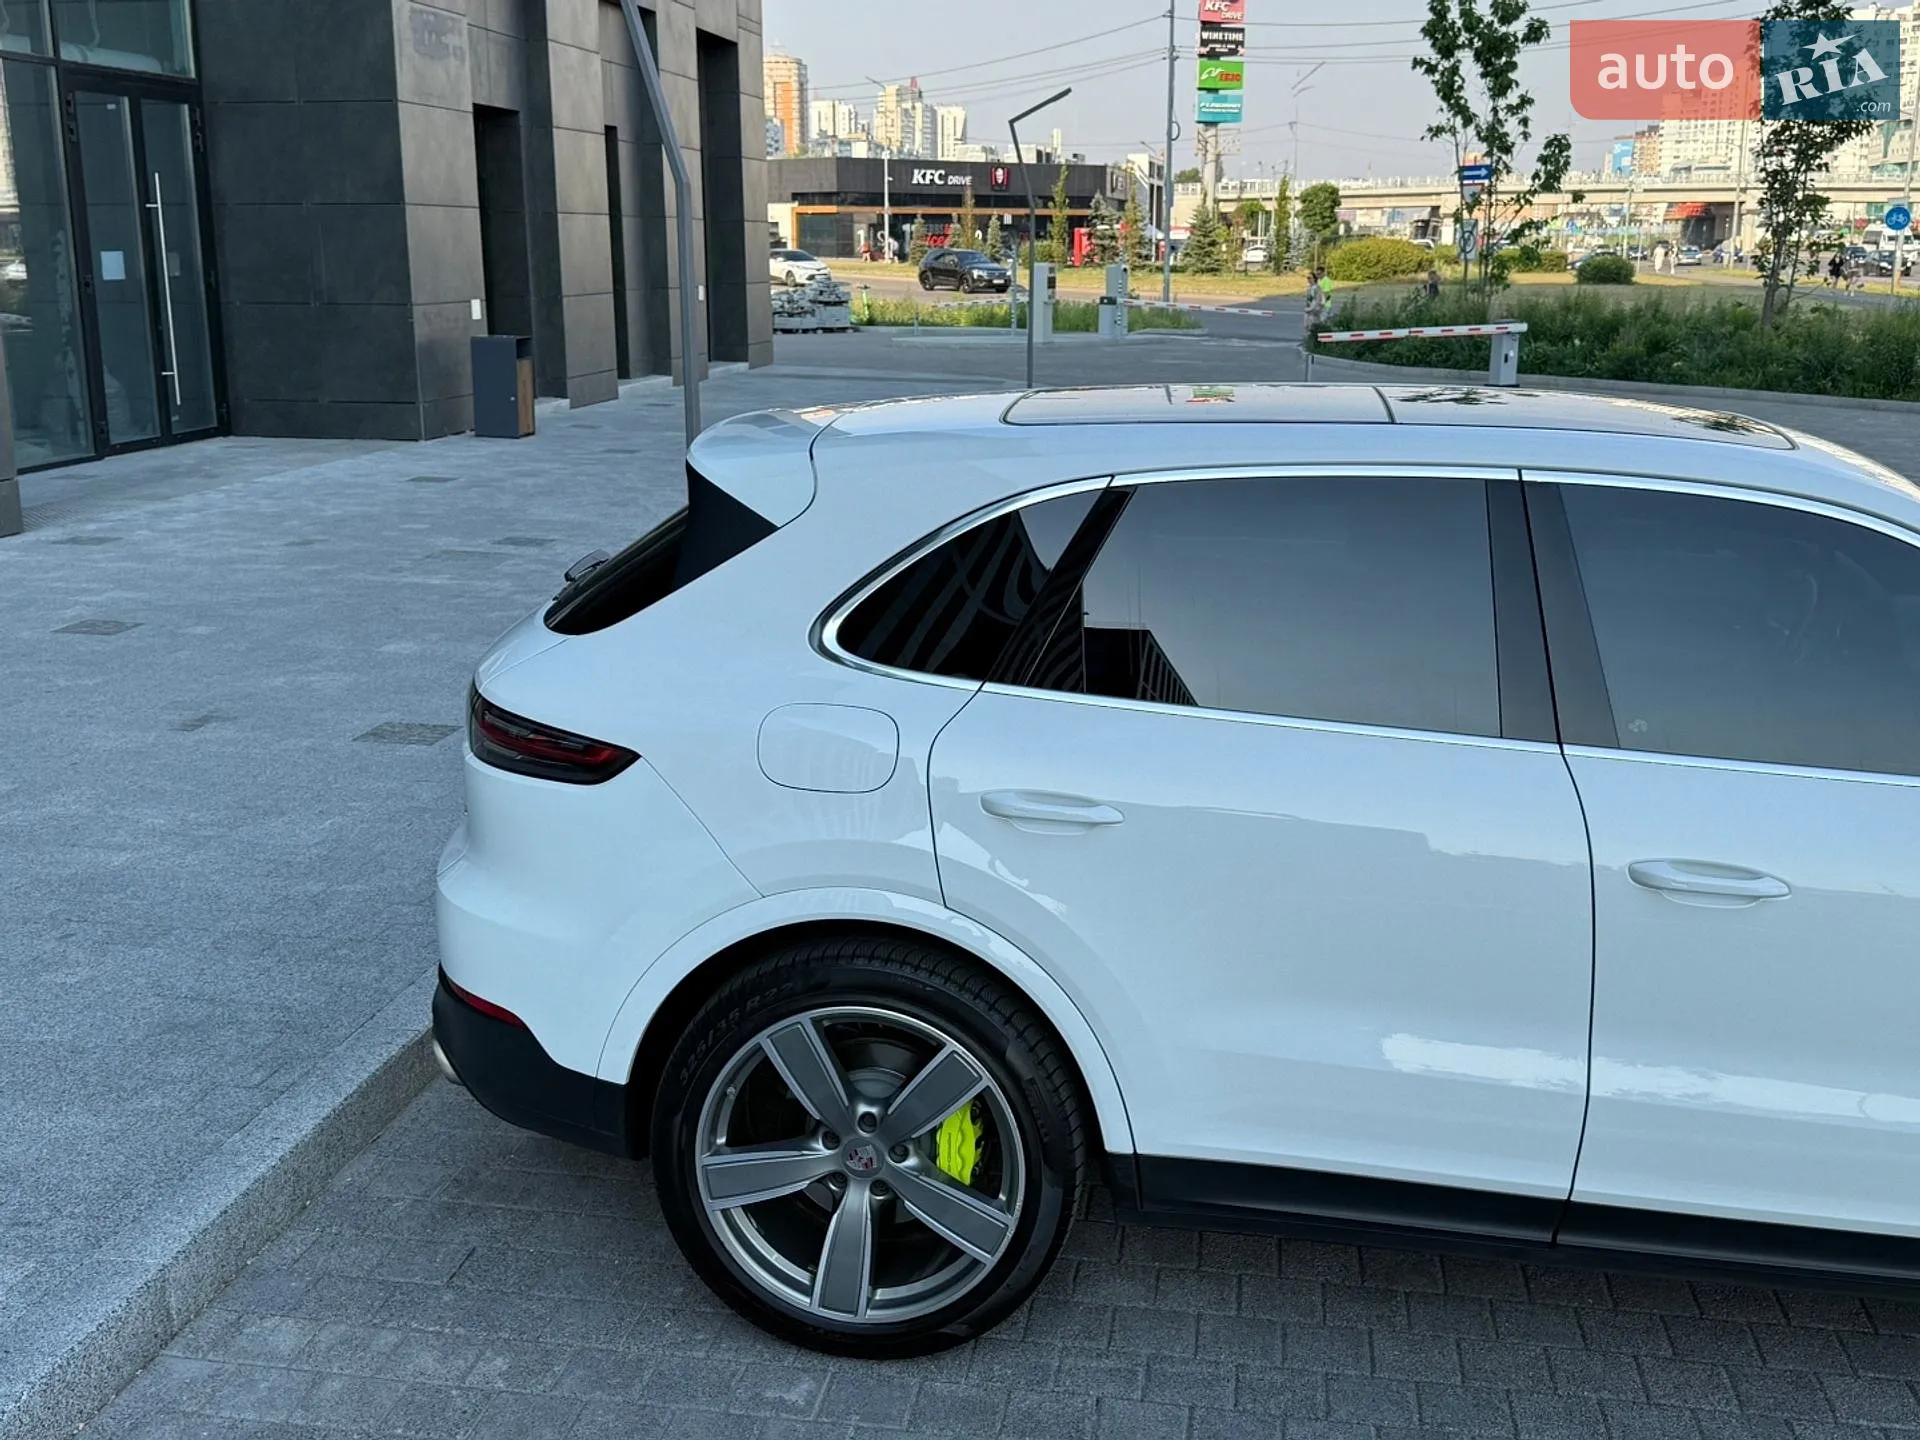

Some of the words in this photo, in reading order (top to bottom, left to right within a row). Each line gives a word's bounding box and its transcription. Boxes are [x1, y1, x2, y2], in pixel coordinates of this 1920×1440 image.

[1203, 0, 1231, 12] KFC
[911, 168, 946, 185] KFC
[947, 175, 973, 186] DRIVE
